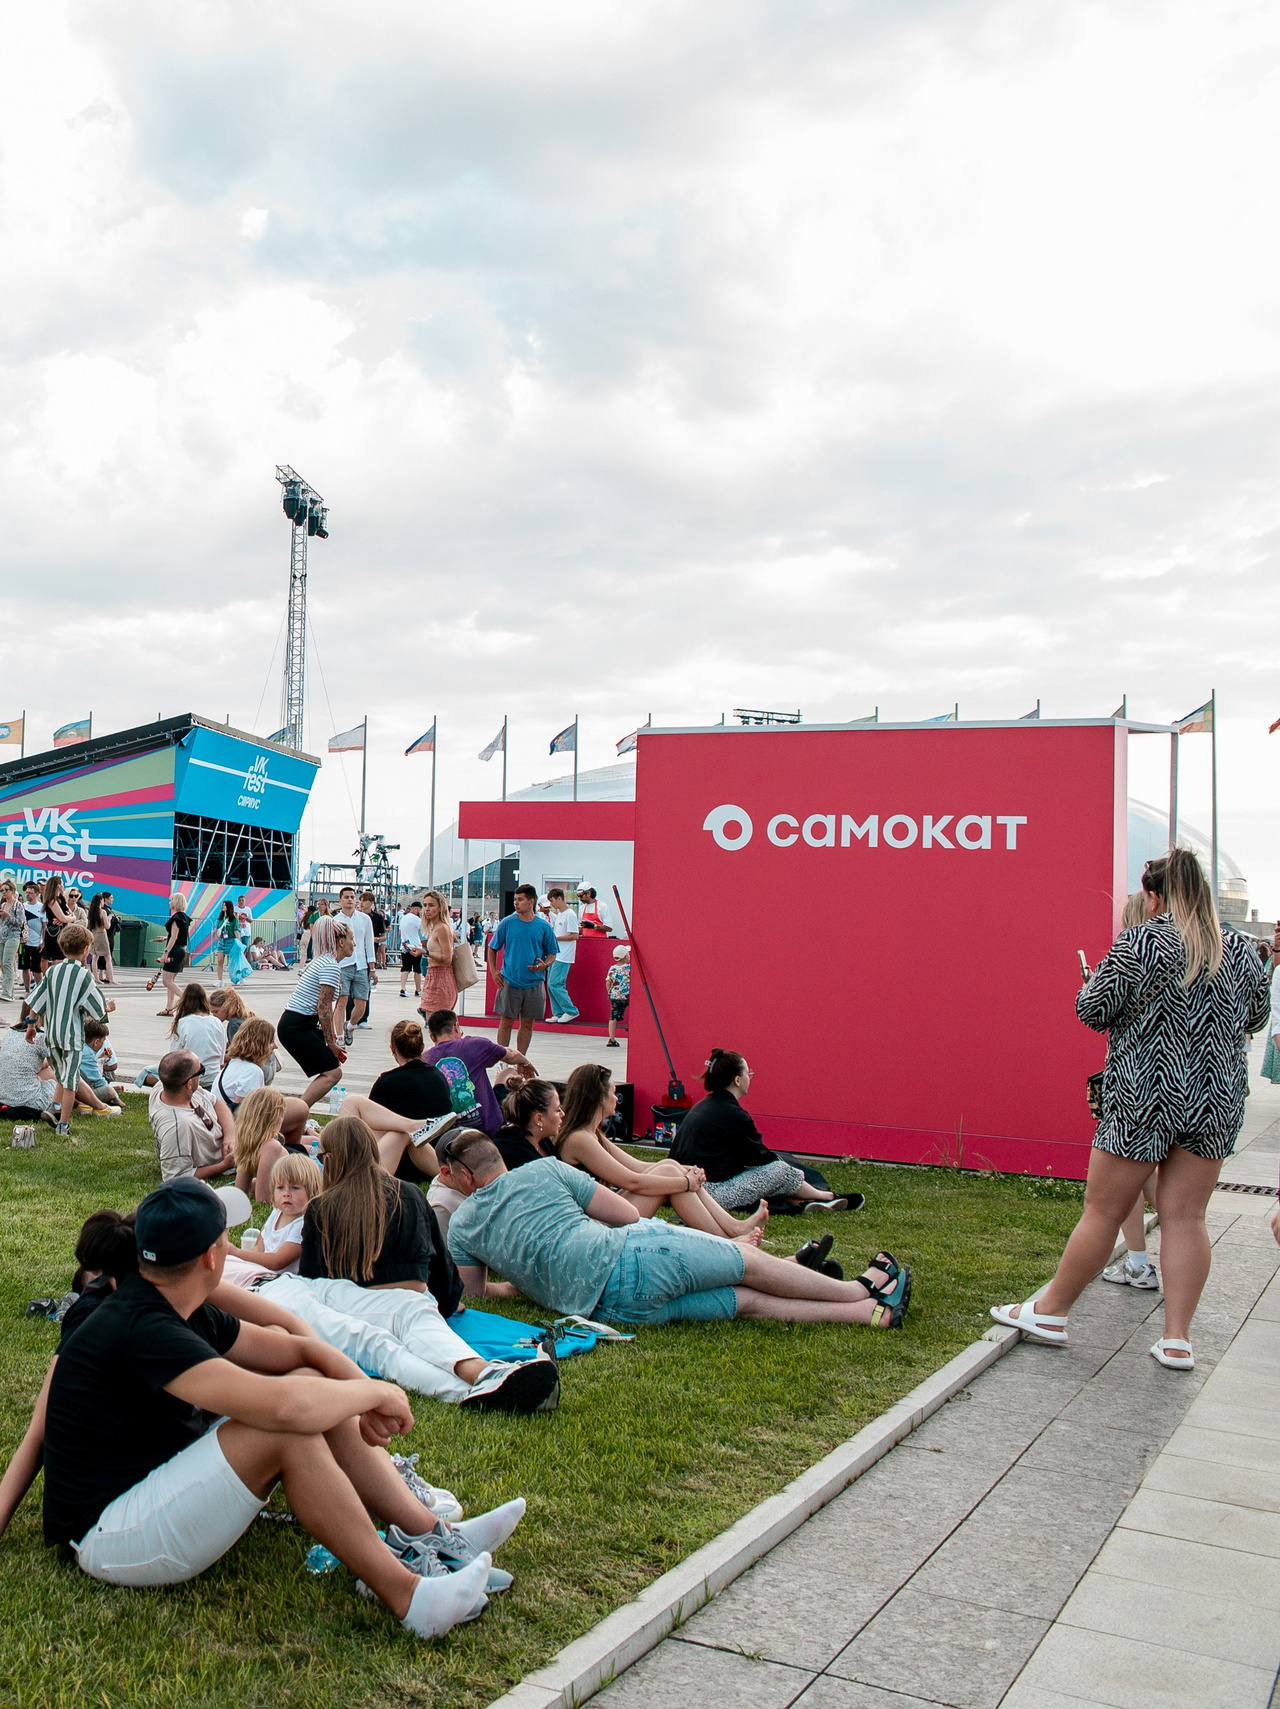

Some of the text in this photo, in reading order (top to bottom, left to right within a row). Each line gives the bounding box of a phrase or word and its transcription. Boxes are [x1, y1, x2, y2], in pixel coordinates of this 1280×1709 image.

[253, 755, 269, 774] VK
[243, 766, 268, 794] fest
[23, 807, 79, 833] VK
[4, 824, 98, 863] fest
